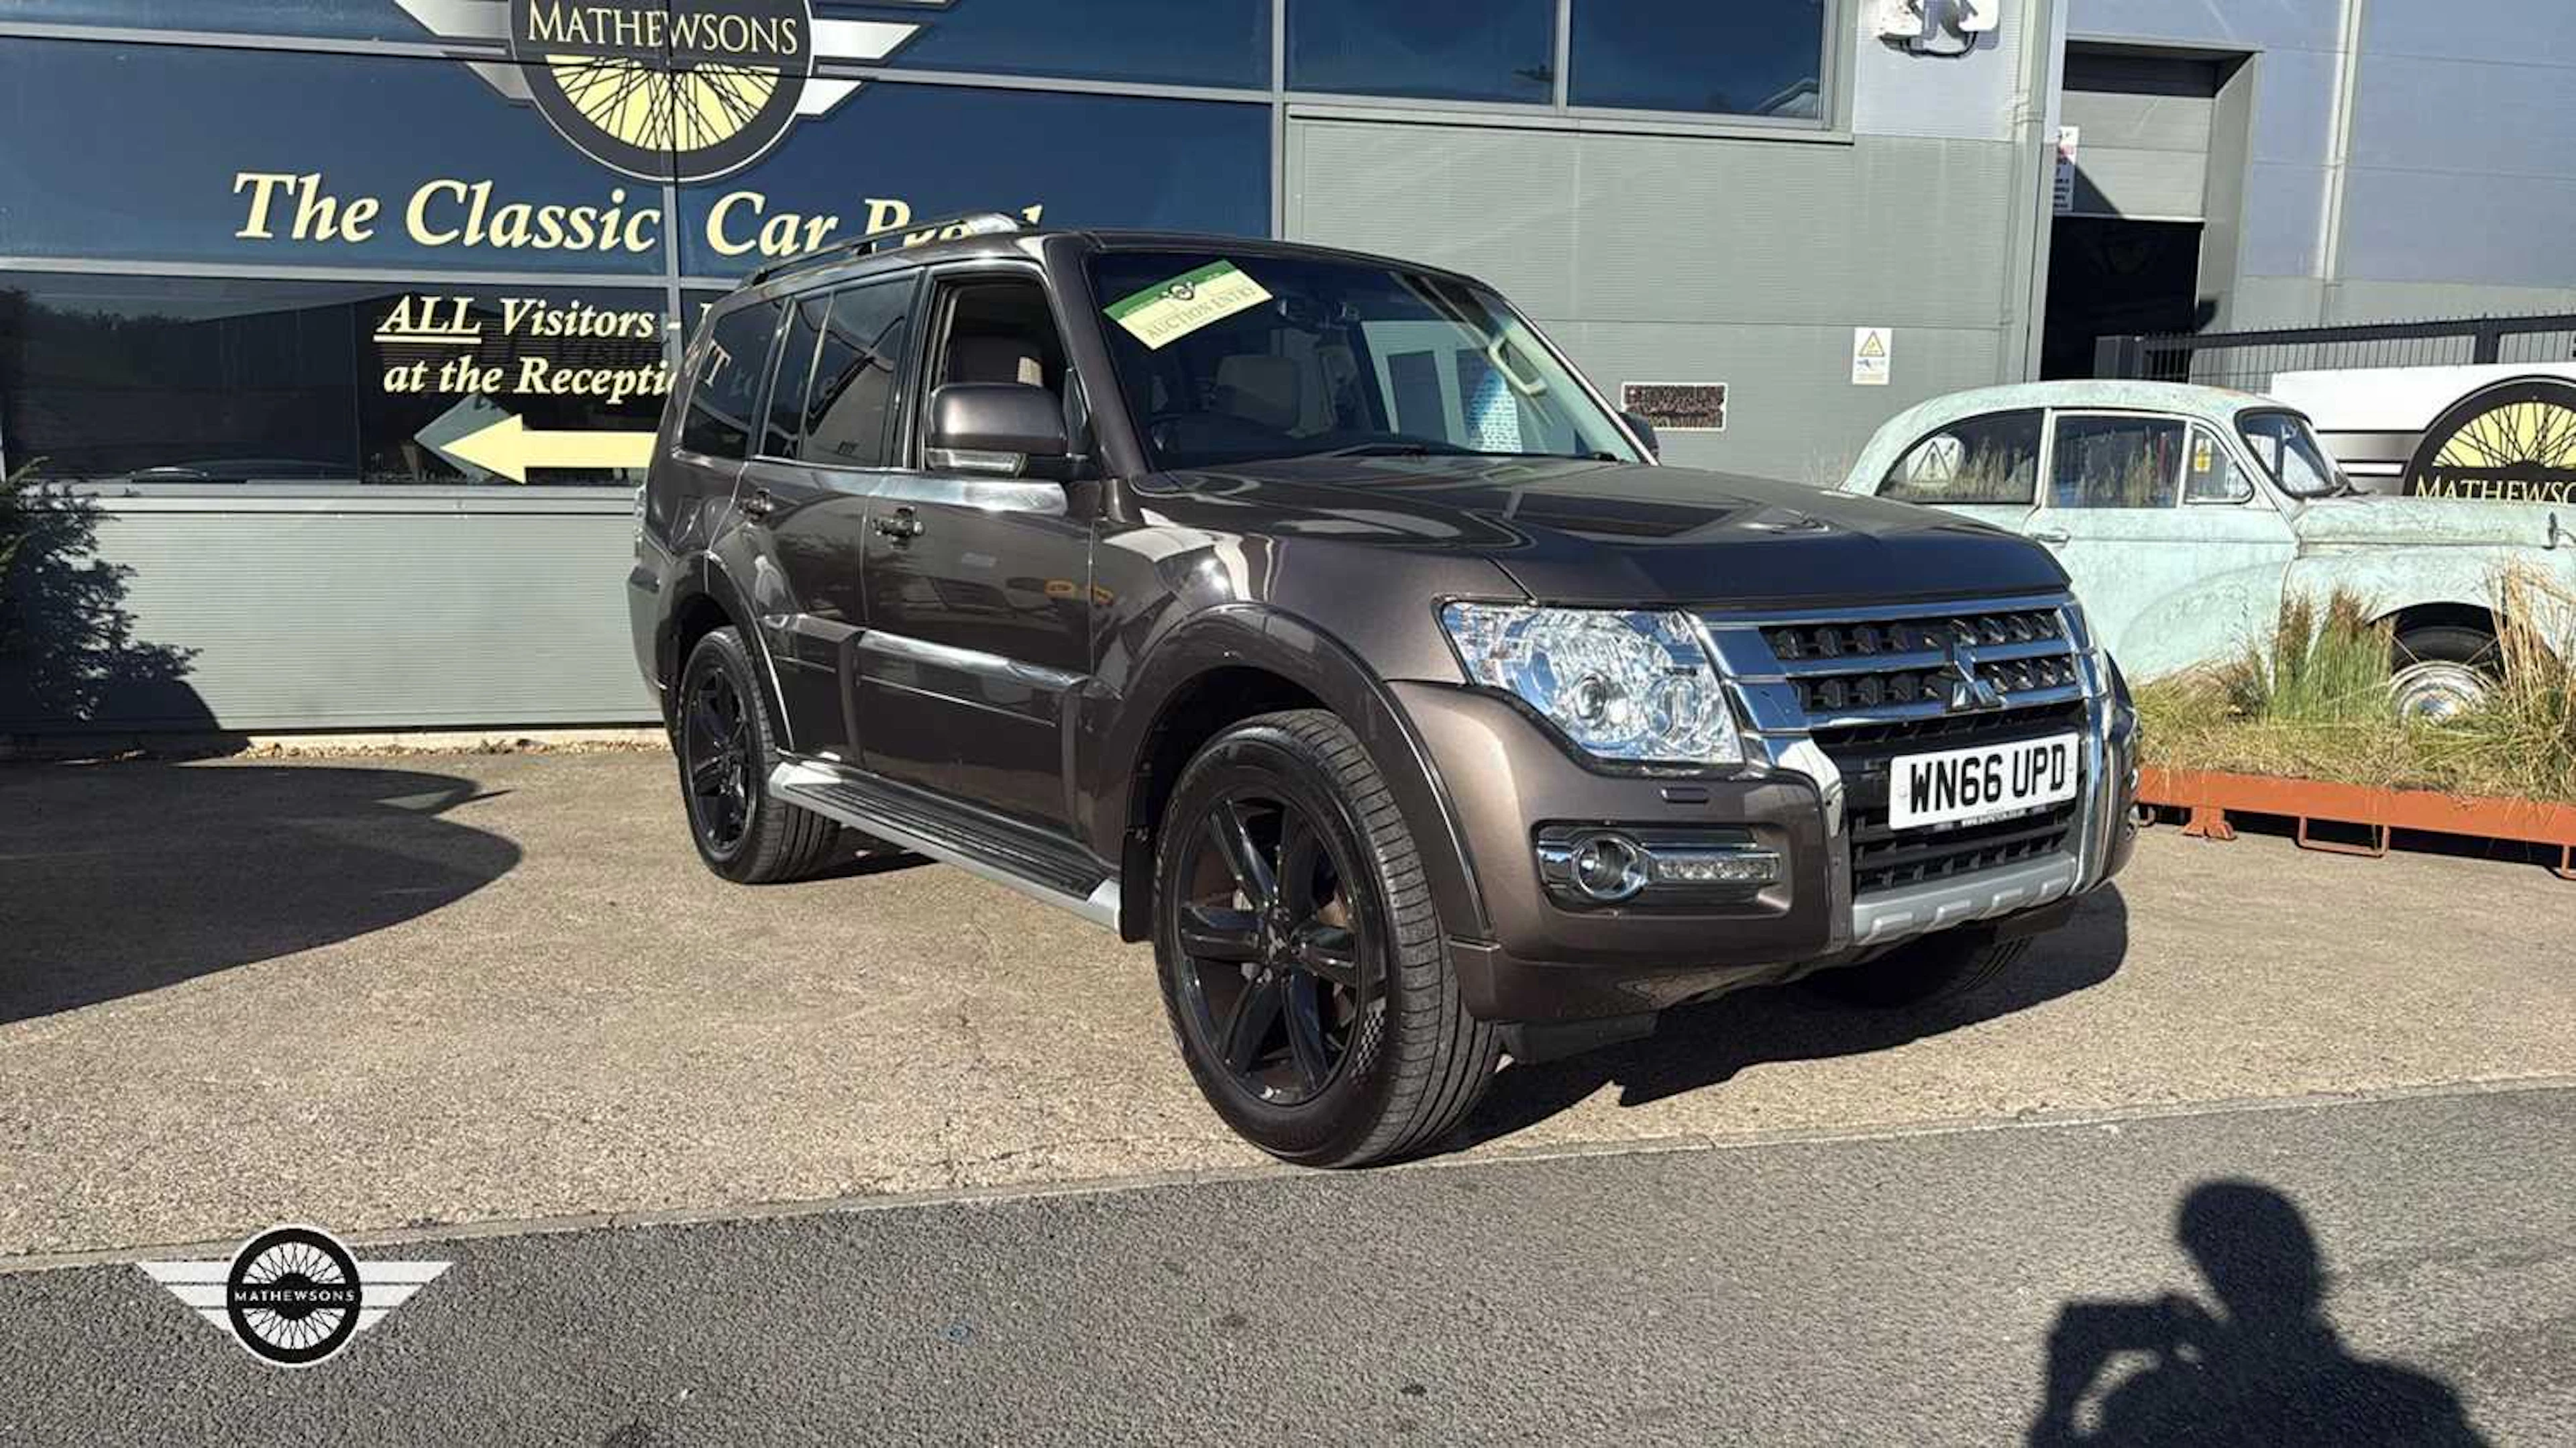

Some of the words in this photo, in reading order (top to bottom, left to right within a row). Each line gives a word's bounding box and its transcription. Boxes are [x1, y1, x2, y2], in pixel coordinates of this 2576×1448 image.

[527, 0, 798, 55] MATHEWSONS
[233, 172, 380, 242] The
[405, 179, 661, 252] Classic
[706, 191, 839, 256] Car
[376, 295, 482, 335] ALL
[500, 298, 655, 338] Visitors
[383, 361, 428, 394] at
[439, 354, 504, 395] the
[1911, 754, 2002, 813] WN66
[2012, 744, 2065, 797] UPD
